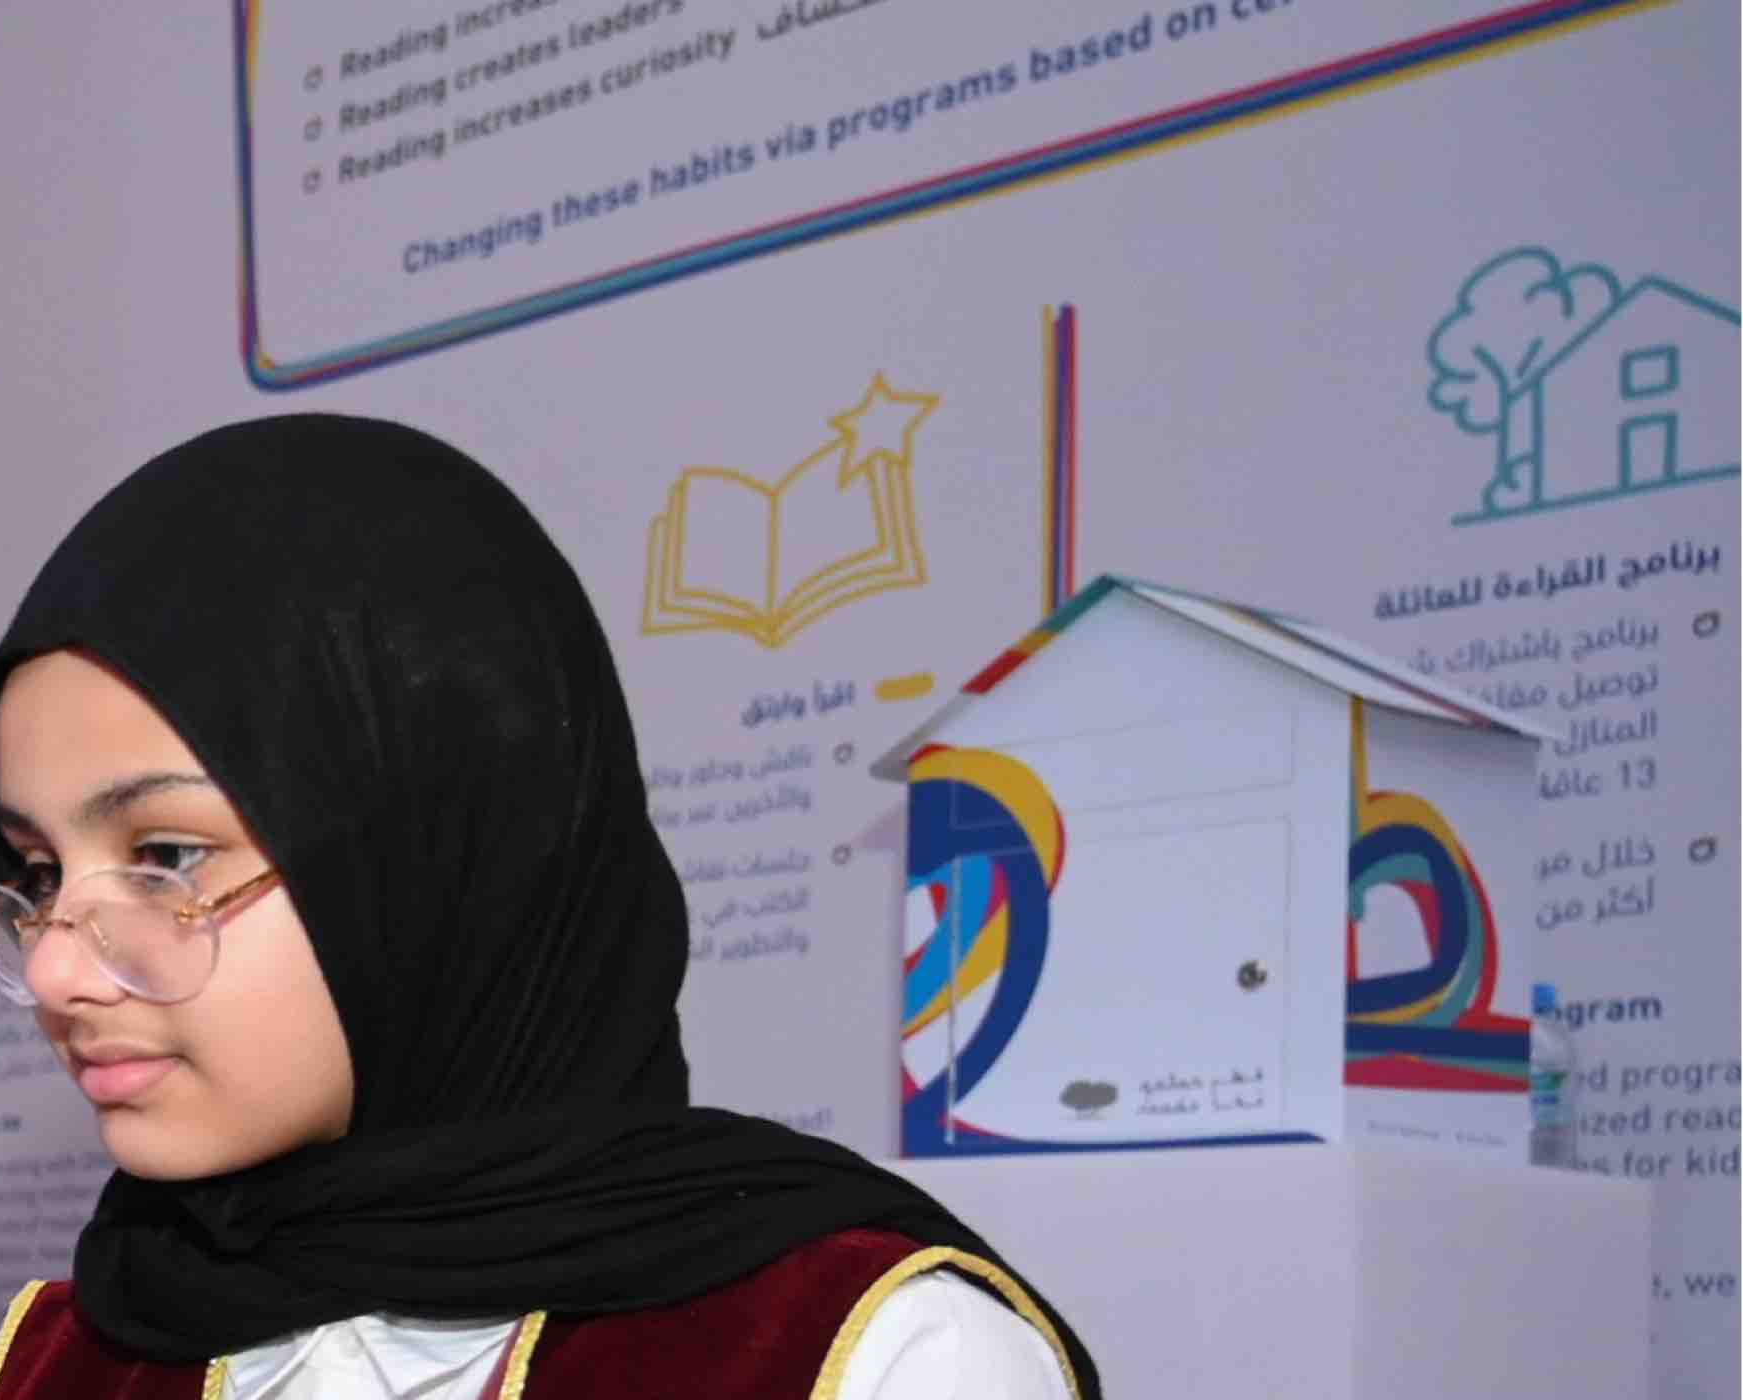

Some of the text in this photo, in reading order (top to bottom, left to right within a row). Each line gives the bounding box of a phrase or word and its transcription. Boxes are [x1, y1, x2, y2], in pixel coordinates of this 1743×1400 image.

[339, 0, 684, 132] Reading creates leaders
[340, 22, 448, 79] Reading
[338, 29, 736, 182] Reading increases curiosity
[403, 210, 543, 273] Changing
[551, 179, 642, 227] these
[649, 143, 755, 195] habits
[765, 122, 817, 160] via
[827, 61, 1018, 150] programs
[1028, 14, 1154, 83] based
[1163, 2, 1217, 39] on
[1374, 540, 1720, 620] برنامج القراءة للعائلة
[1571, 617, 1660, 661] برنامج
[1557, 663, 1660, 711] توصيل
[1619, 757, 1656, 790] 13
[1581, 833, 1657, 878] خلال
[1620, 1061, 1739, 1098] progra
[1579, 1102, 1651, 1137] ized
[1623, 1149, 1673, 1179] for
